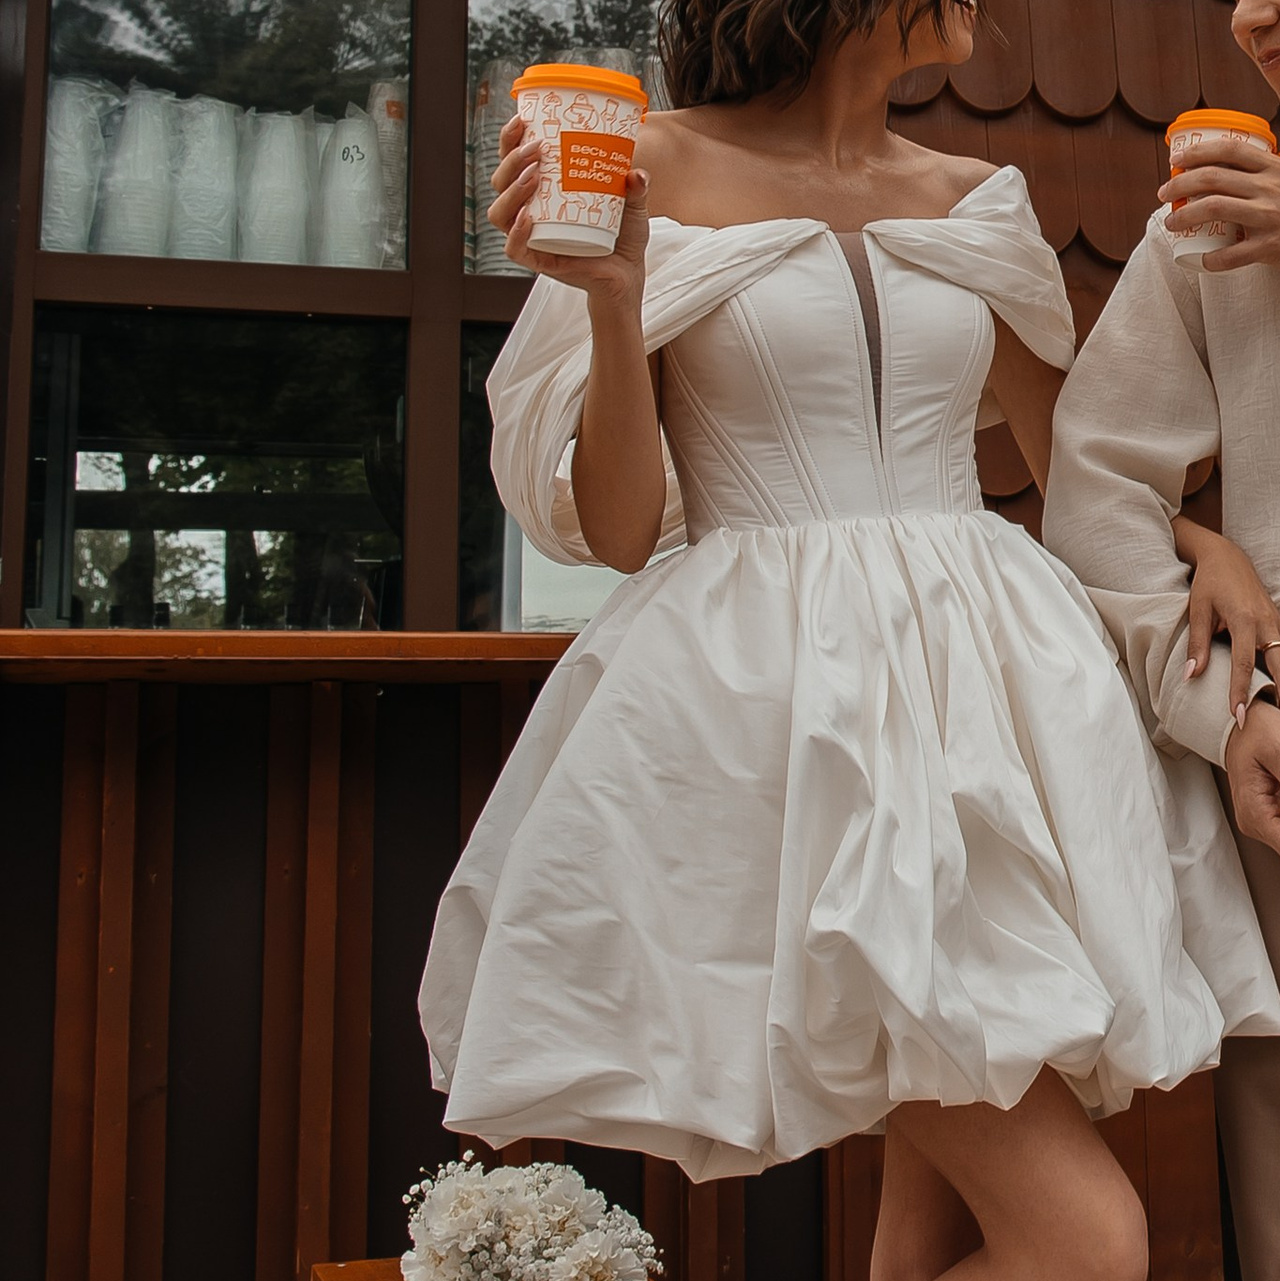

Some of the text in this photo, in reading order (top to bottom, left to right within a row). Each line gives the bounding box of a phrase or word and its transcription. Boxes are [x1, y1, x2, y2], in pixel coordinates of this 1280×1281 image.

[342, 145, 365, 164] 0,3
[570, 144, 631, 167] весь ден
[569, 157, 629, 176] на рыже
[569, 169, 612, 184] вайбе
